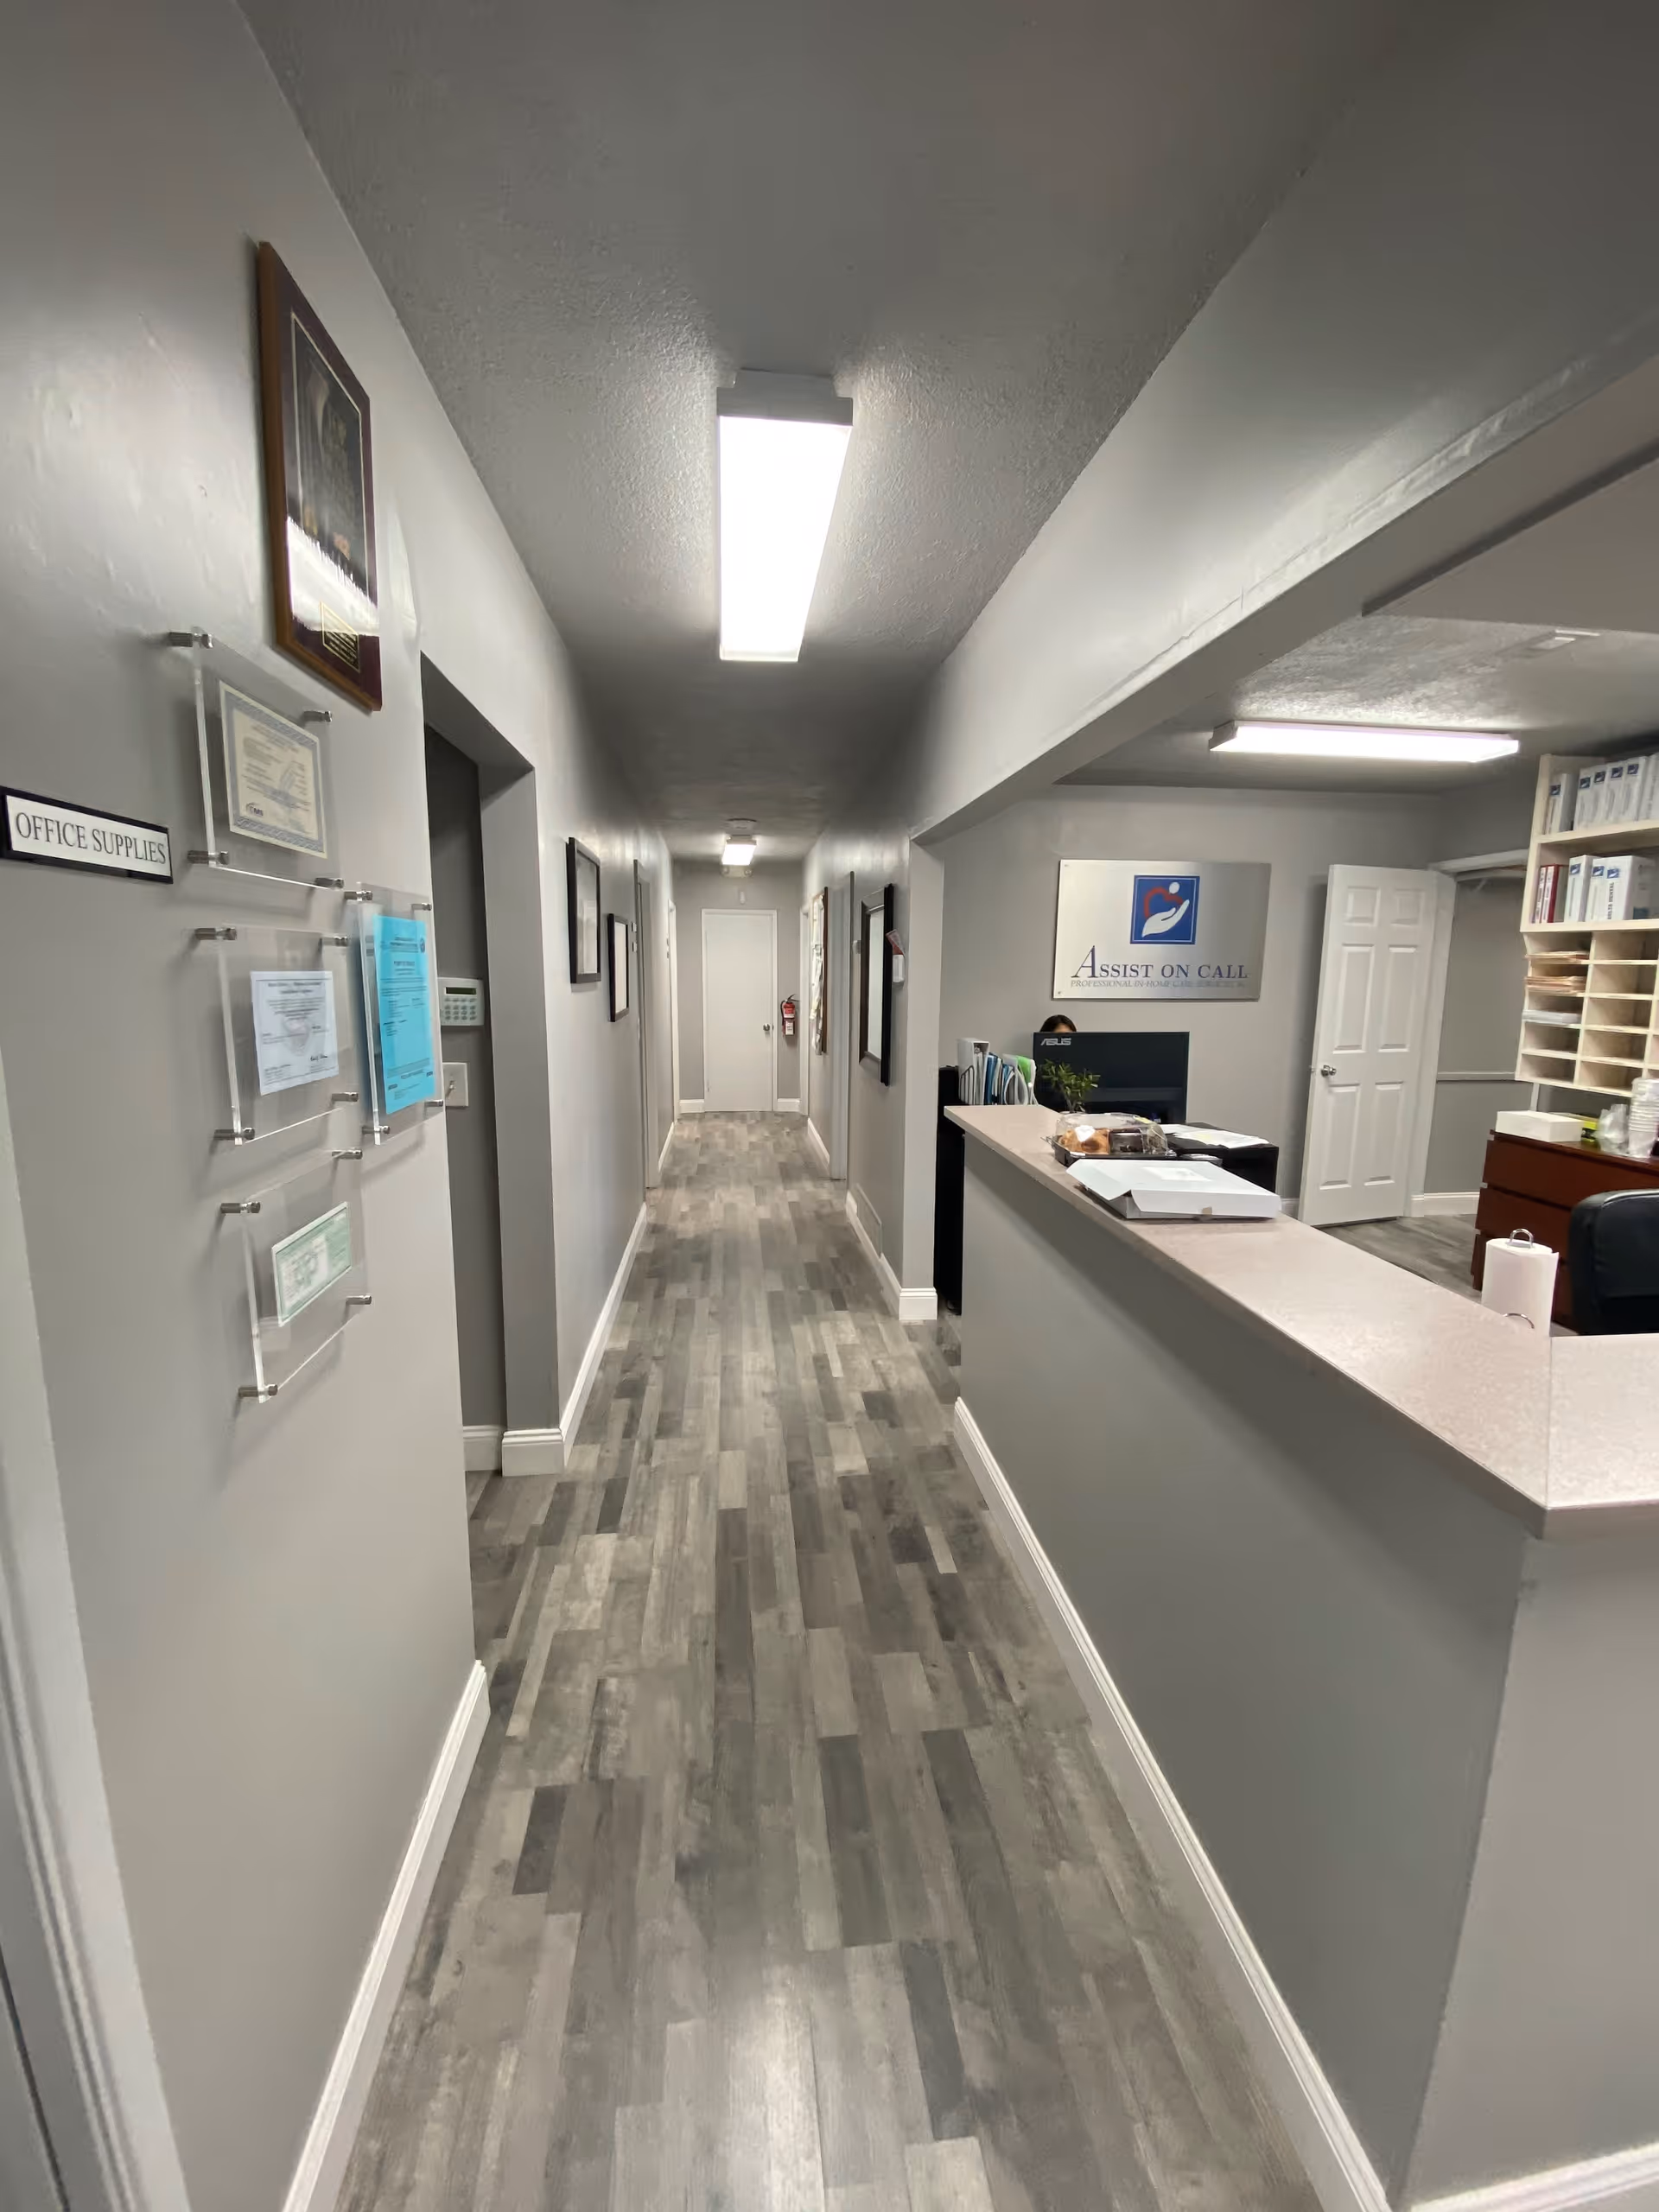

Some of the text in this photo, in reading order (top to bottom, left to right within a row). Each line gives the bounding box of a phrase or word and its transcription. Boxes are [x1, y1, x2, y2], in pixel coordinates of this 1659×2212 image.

[16, 812, 166, 864] OFFICE SUPPLIES
[1160, 963, 1190, 978] ON
[1198, 963, 1248, 978] CALL
